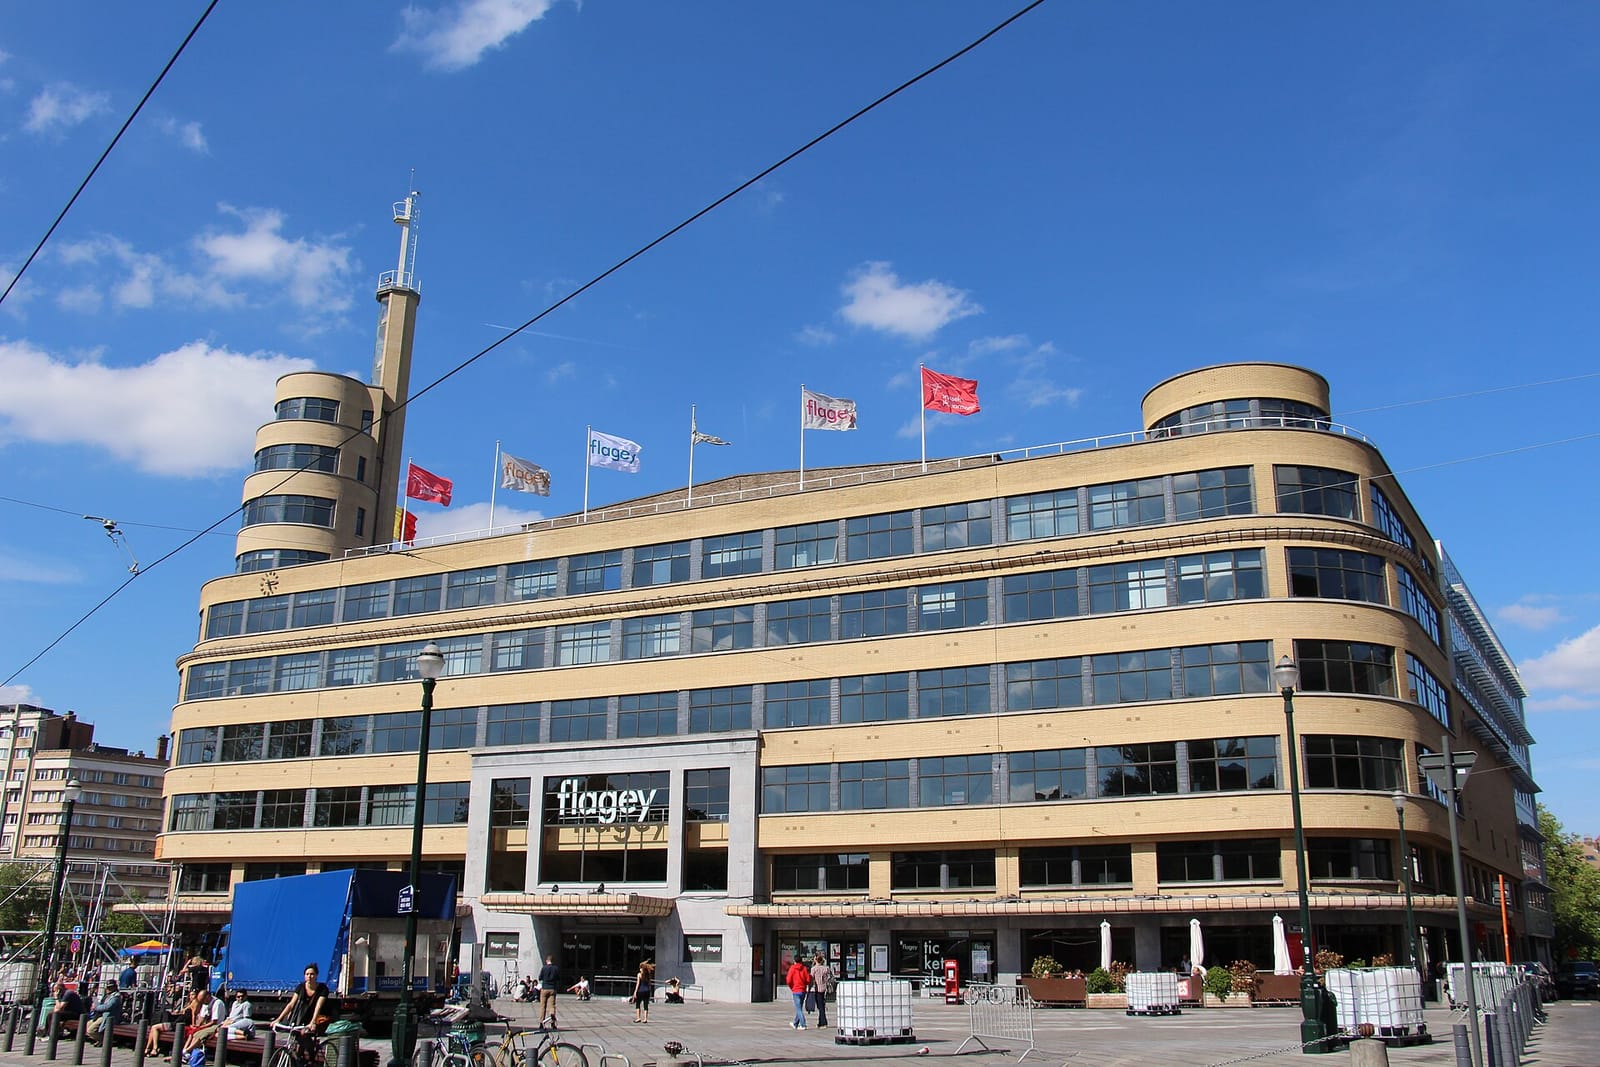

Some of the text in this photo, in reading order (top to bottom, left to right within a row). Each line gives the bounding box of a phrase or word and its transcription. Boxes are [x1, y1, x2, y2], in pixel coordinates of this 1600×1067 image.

[590, 439, 636, 464] flagey
[557, 779, 657, 824] flagey
[924, 940, 940, 954] tic
[924, 969, 946, 986] sho
